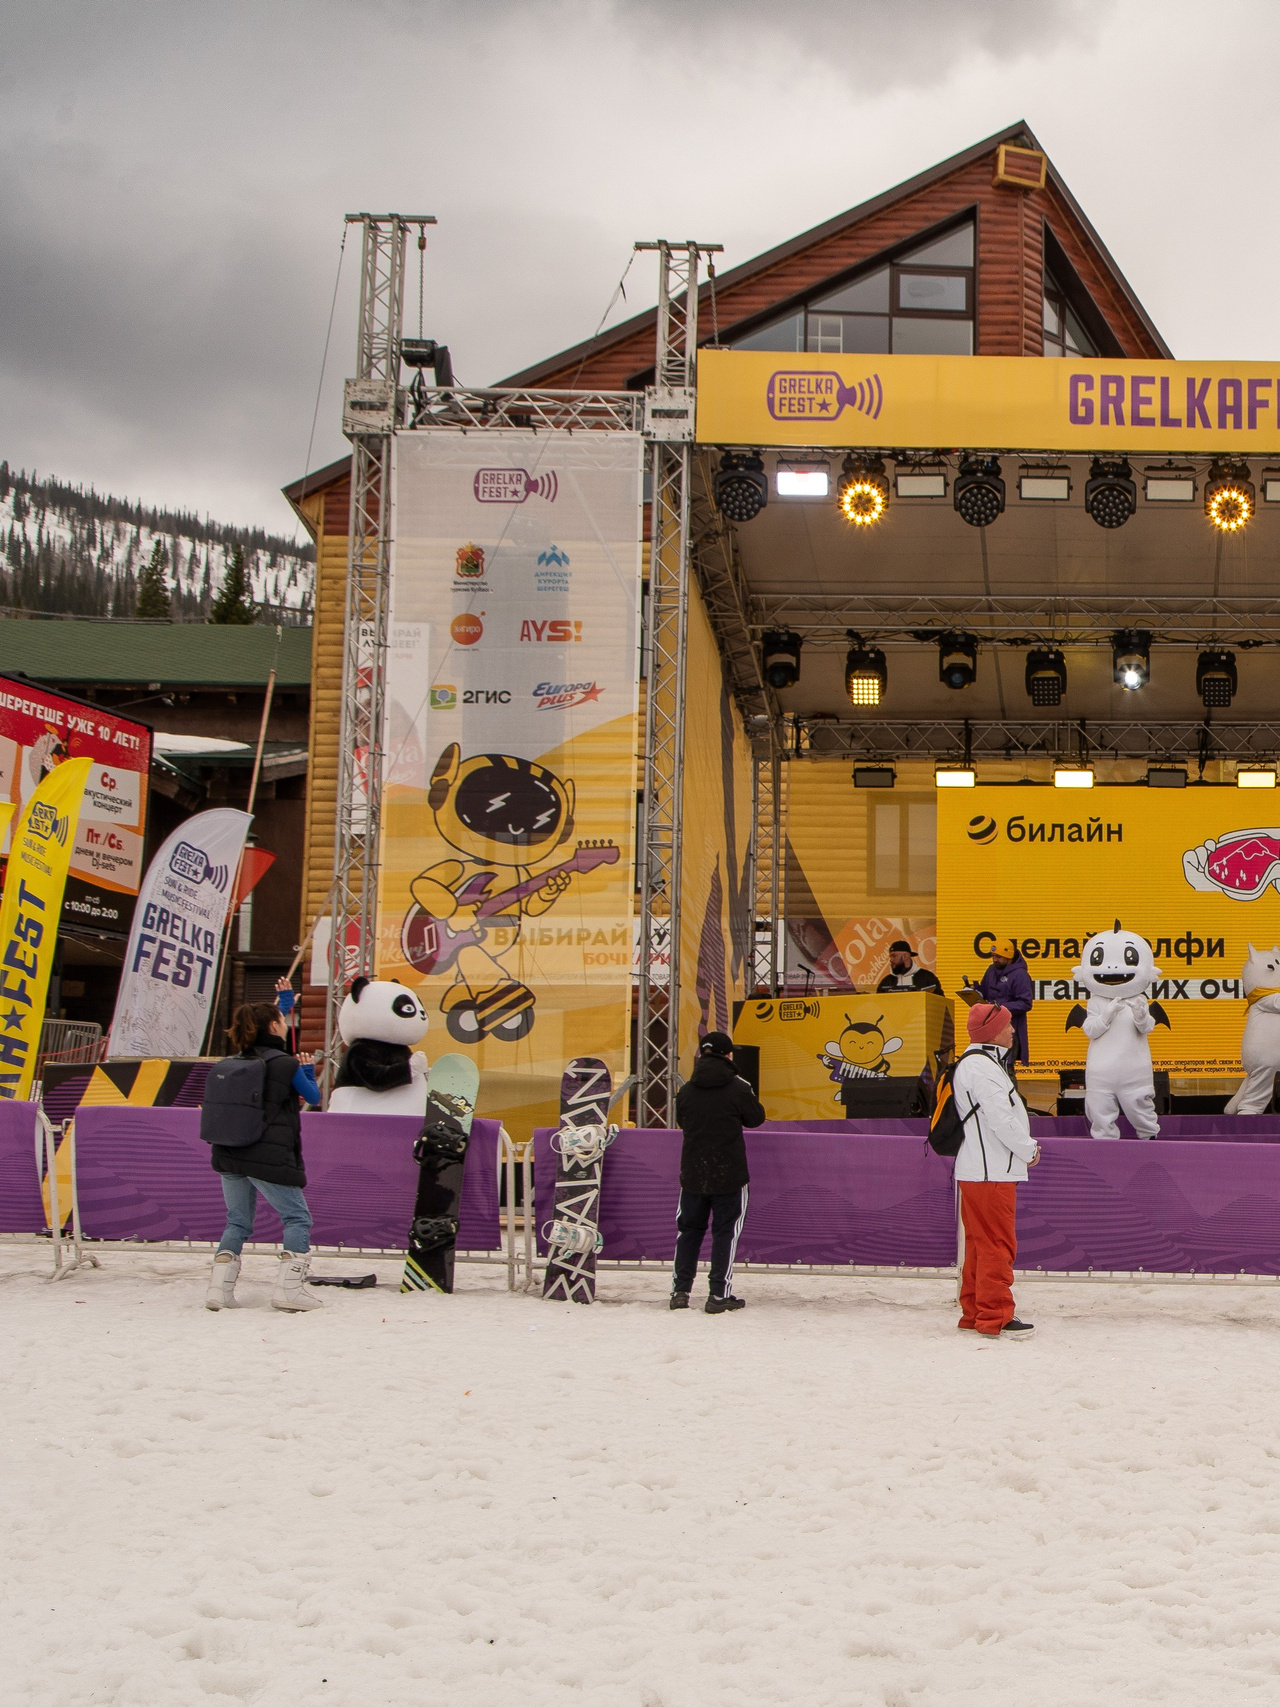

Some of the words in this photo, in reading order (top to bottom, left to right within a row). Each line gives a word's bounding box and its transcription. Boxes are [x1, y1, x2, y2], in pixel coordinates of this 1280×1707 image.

[778, 377, 833, 395] GRELKA
[778, 397, 816, 413] FEST
[482, 473, 523, 485] GRELKA
[482, 486, 509, 498] FEST
[519, 619, 583, 642] AYS!
[462, 690, 512, 704] 2ГИС
[67, 713, 95, 736] УЖЕ
[97, 725, 111, 741] 10
[112, 731, 140, 751] ЛЕТ!
[84, 788, 133, 808] акустический
[92, 799, 123, 815] концерт
[1006, 815, 1123, 842] билайн
[74, 846, 95, 858] днем
[101, 854, 134, 867] вечером
[173, 858, 193, 875] FEST
[70, 901, 91, 914] 10:00
[90, 906, 102, 917] до
[101, 908, 119, 919] 2:00
[141, 902, 215, 957] GRELKA
[494, 922, 628, 946] ВЫБИРАЙ
[0, 878, 46, 1008] FEST
[132, 933, 214, 995] FEST
[782, 1002, 804, 1011] GRELKA
